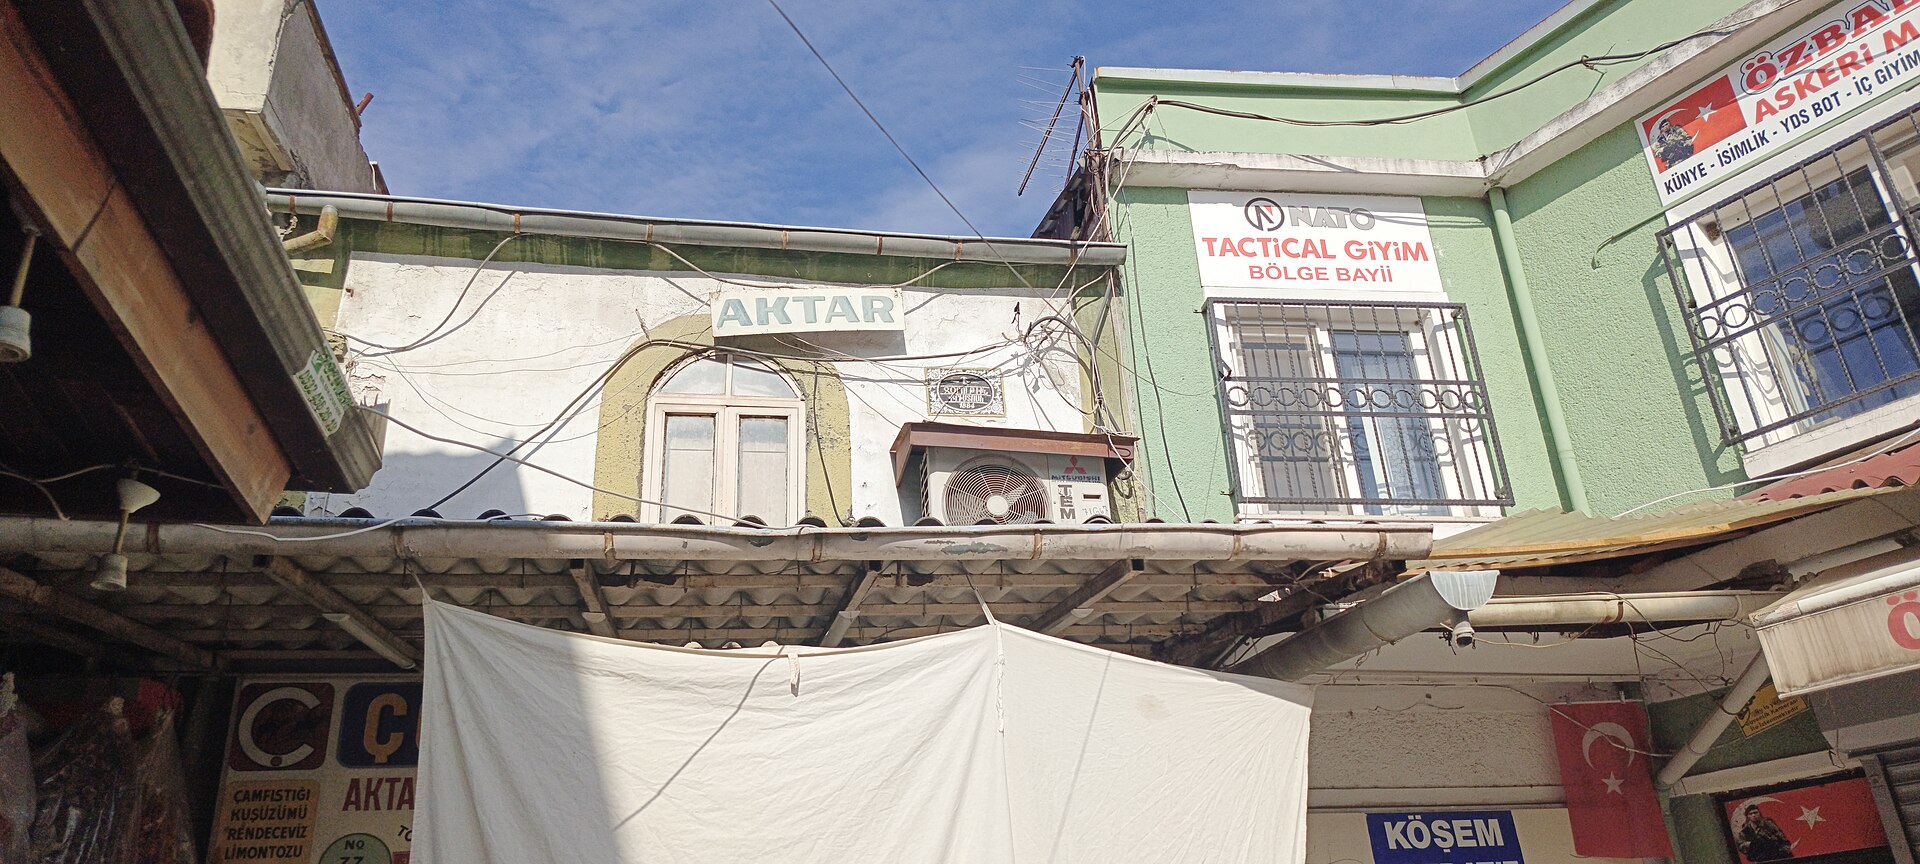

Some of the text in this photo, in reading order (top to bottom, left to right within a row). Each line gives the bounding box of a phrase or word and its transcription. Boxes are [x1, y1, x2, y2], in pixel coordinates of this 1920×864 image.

[1664, 162, 1708, 195] KÜNYE
[1716, 129, 1770, 167] İSİMLİK
[1780, 109, 1810, 134] YDS
[1814, 92, 1842, 119] BOT
[1855, 76, 1873, 96] İÇ
[1288, 205, 1376, 230] NATO
[1249, 263, 1330, 281] BÖLGE
[716, 294, 895, 329] AKTAR
[363, 693, 422, 764] Ç
[233, 787, 310, 803] ÇAMFISTIĞI
[230, 805, 308, 822] KUŞÜZÜMÜ
[227, 823, 308, 841] RENDECEVİZ
[1383, 814, 1504, 852] KÖŞEM
[224, 844, 303, 860] LİMONTOZU
